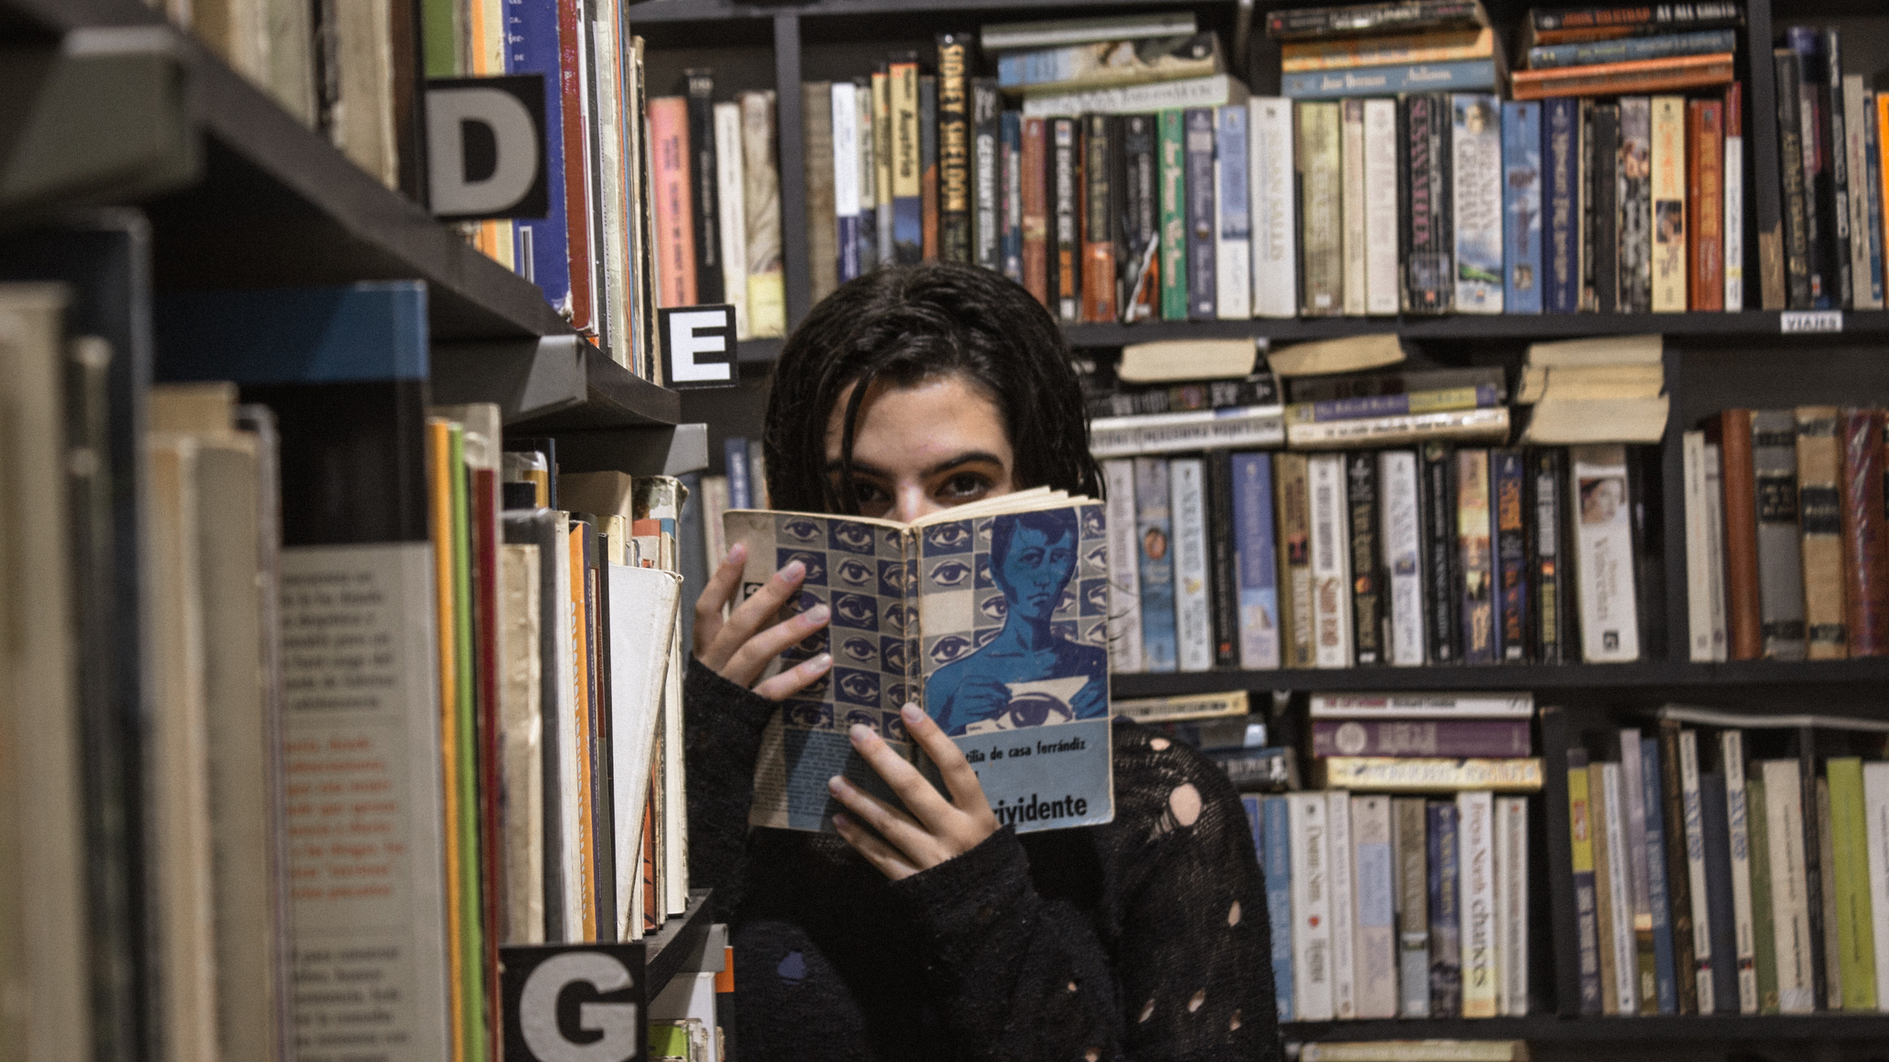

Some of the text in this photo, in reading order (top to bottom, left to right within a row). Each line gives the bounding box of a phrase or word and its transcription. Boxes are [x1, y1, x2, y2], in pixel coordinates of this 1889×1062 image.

[939, 44, 966, 113] SIDNEY
[426, 87, 539, 217] D
[899, 109, 915, 178] Austria
[940, 120, 967, 212] SHELDON
[1458, 138, 1477, 231] GRAHAM
[669, 310, 731, 382] E
[1785, 315, 1841, 331] VIAJES
[966, 737, 1086, 763] tilia de casa ferrándiz
[992, 793, 1087, 825] rividente
[1470, 900, 1490, 988] chances
[519, 952, 638, 1062] G
